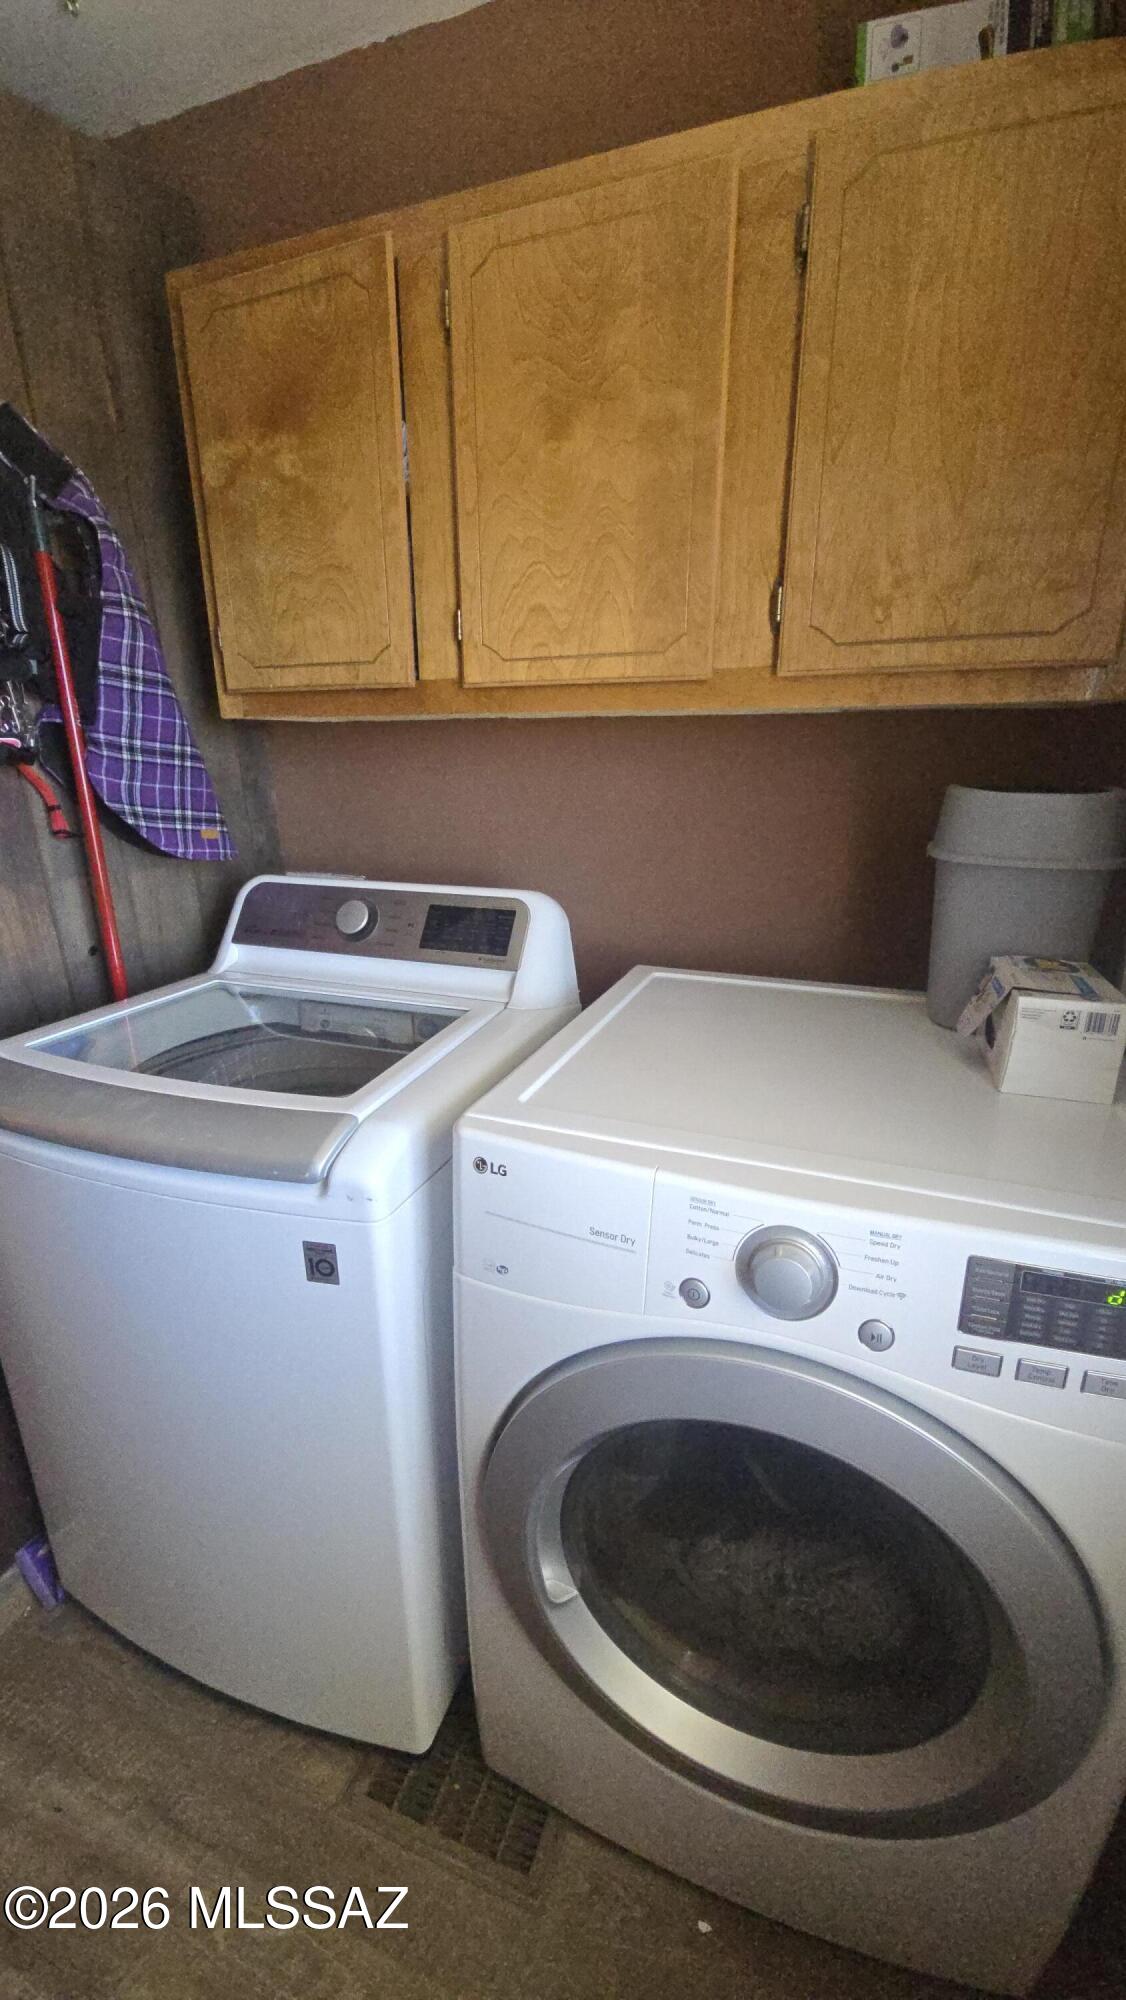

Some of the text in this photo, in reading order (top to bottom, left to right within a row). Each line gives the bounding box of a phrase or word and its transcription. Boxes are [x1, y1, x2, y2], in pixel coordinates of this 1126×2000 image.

[490, 1162, 507, 1177] LG
[589, 1226, 636, 1247] Sensor Dry
[889, 1241, 901, 1250] Dry
[864, 1254, 900, 1267] Freshen Up
[886, 1274, 897, 1283] Dry
[848, 1283, 879, 1295] Download
